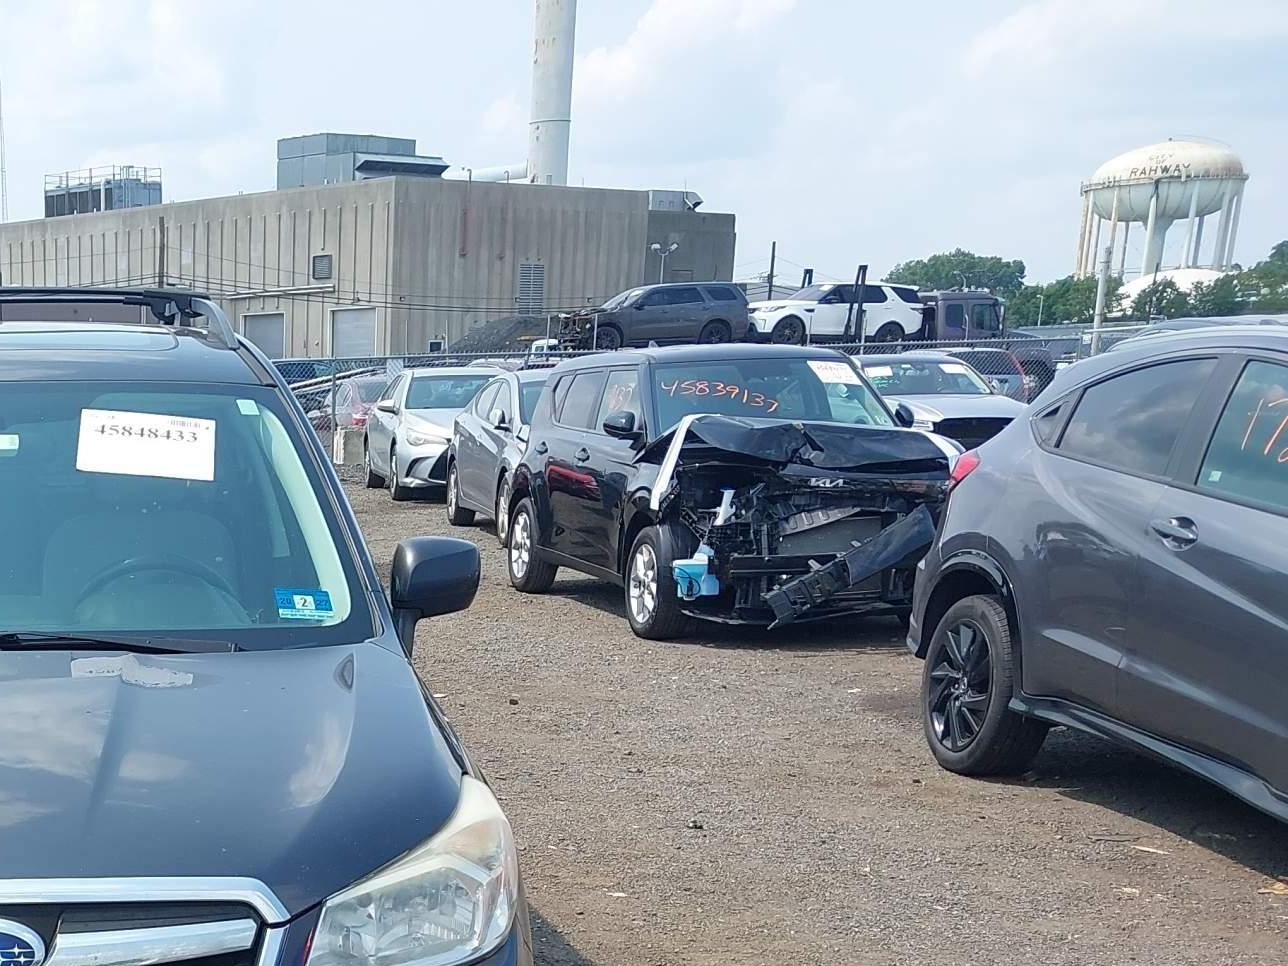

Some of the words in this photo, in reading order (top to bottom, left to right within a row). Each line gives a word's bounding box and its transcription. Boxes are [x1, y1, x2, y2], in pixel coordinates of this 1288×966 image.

[1128, 162, 1191, 178] RAHWAY
[661, 379, 779, 413] 45839137
[94, 424, 198, 443] 45848433
[299, 596, 309, 608] 2
